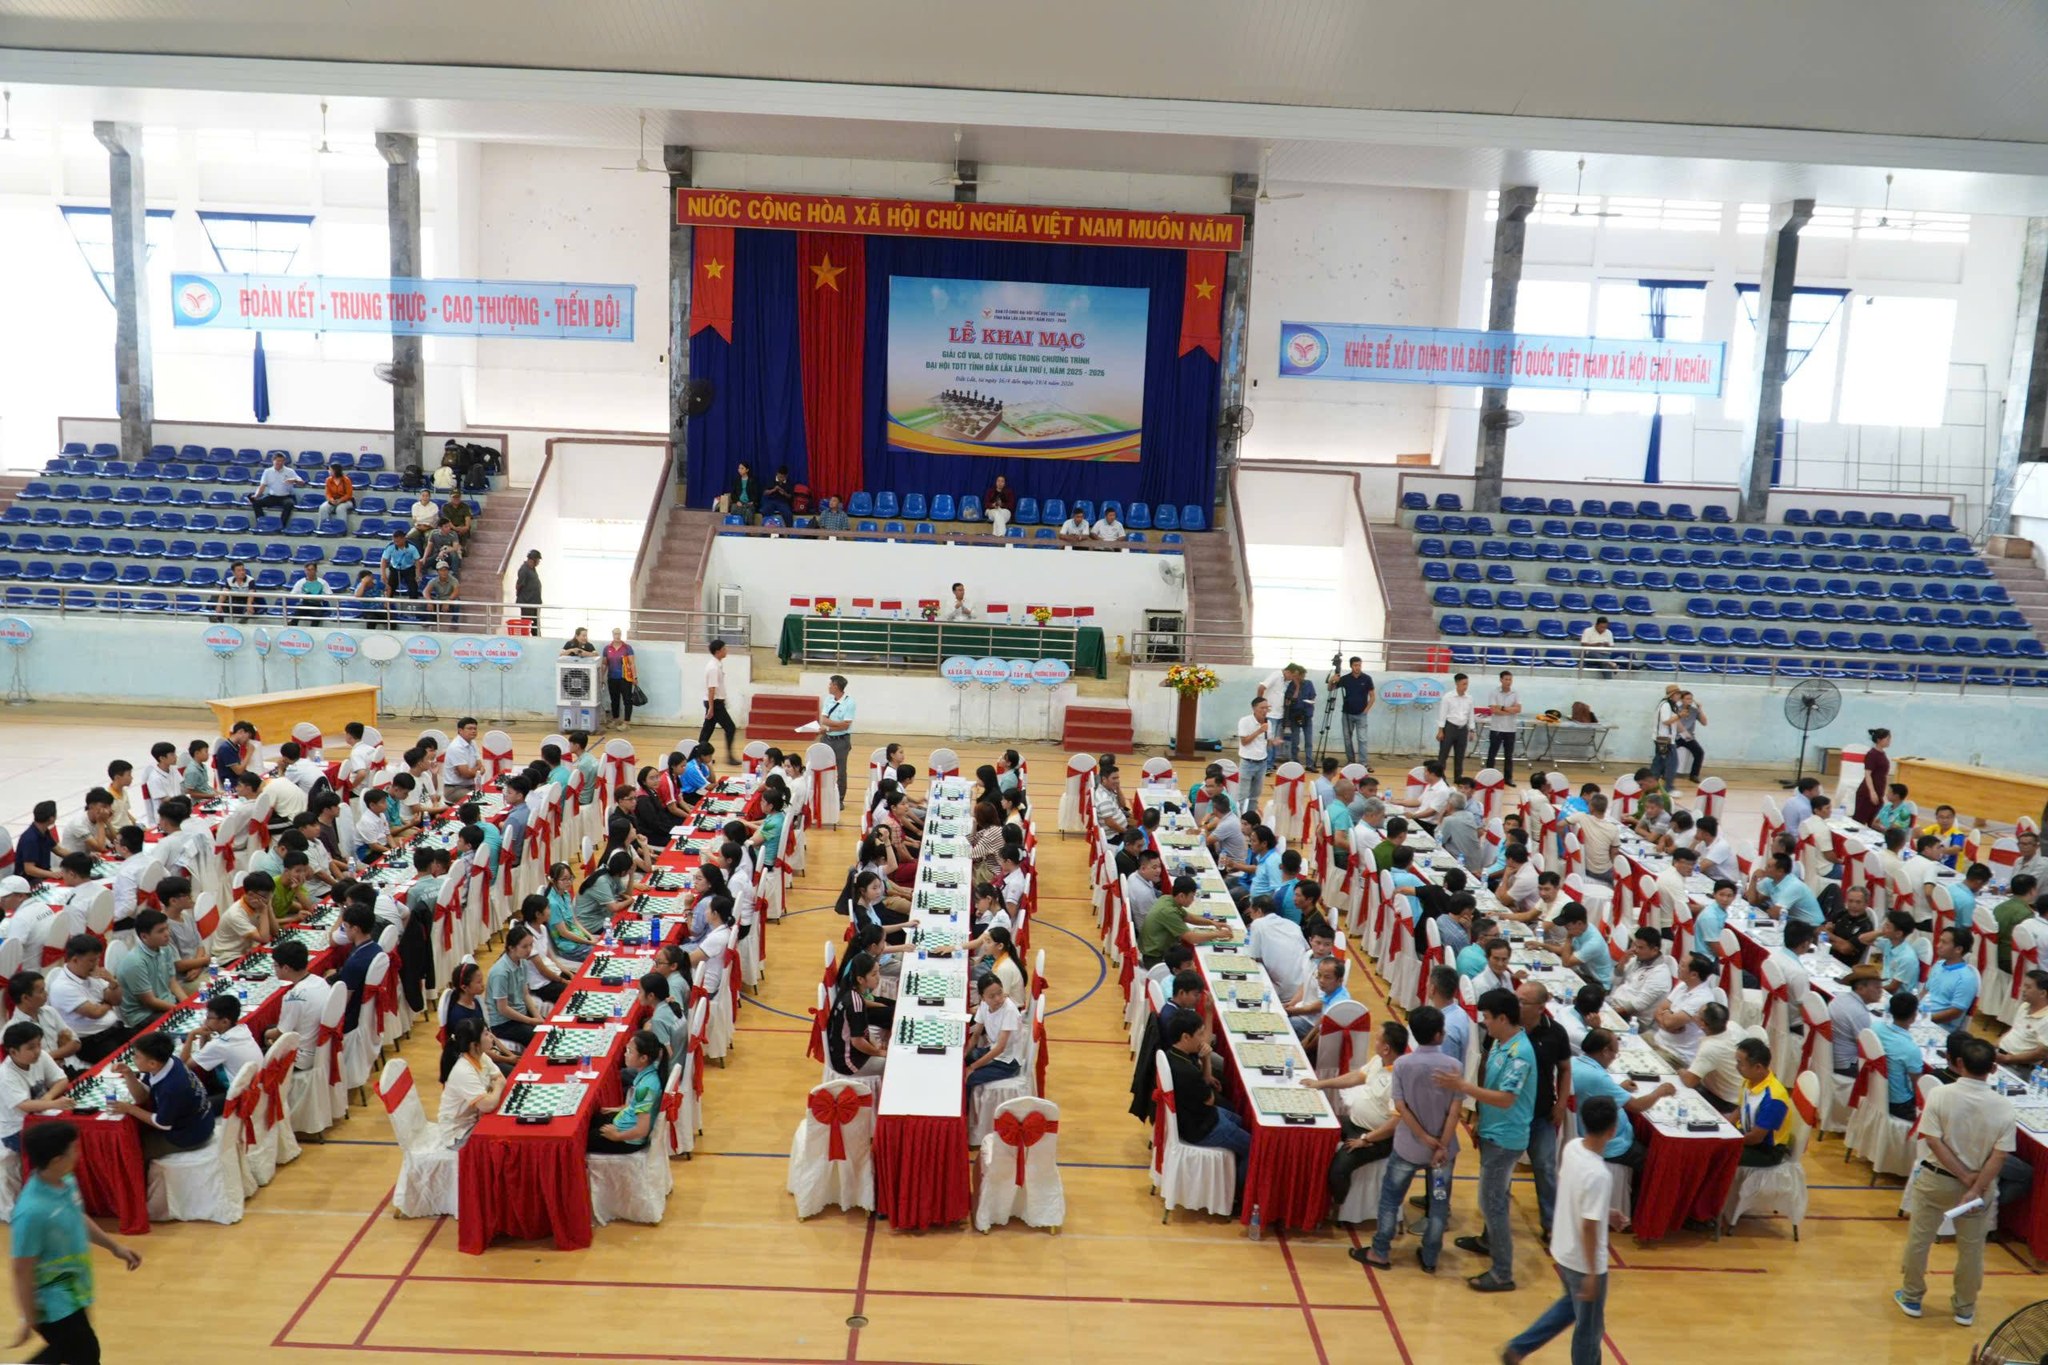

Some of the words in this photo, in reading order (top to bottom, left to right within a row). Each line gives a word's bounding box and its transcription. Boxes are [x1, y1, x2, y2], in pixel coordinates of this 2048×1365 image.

[688, 194, 741, 219] NƯỚC
[747, 196, 801, 224] CỘNG
[807, 198, 846, 225] HÒA
[853, 203, 881, 226] XÃ
[887, 203, 920, 231] HỘI
[926, 204, 965, 231] CHỦ
[970, 207, 1028, 234] NGHĨA
[1032, 211, 1074, 239] VIỆT
[1079, 216, 1123, 238] NAM
[1128, 216, 1185, 240] MUÔN
[1189, 218, 1233, 242] NĂM
[239, 283, 283, 319] ĐOÀN
[288, 281, 315, 319] KẾT
[330, 291, 383, 321] TRUNG
[386, 290, 427, 328] THỰC
[442, 295, 473, 324] CAO
[477, 293, 540, 331] THƯỢNG
[554, 289, 590, 327] TIẾN
[594, 293, 621, 334] BỘ!
[949, 320, 976, 343] LỄ
[982, 328, 1034, 346] KHAI
[1039, 331, 1085, 351] MẠC
[952, 362, 967, 370] TDTT
[1067, 368, 1082, 376] 2025
[1088, 369, 1105, 377] 2026
[1018, 354, 1040, 362] TRONG
[1344, 334, 1374, 368] KHỎE
[1375, 333, 1393, 369] ĐỂ
[1393, 338, 1416, 370] XÂY
[1417, 342, 1448, 376] DỰNG
[1451, 341, 1465, 372] VÀ
[1468, 339, 1490, 373] BẢO
[1493, 343, 1506, 380] VỆ
[1509, 340, 1525, 375] TỔ
[1525, 342, 1554, 377] QUỐC
[1557, 347, 1582, 383] VIỆT
[1583, 353, 1608, 378] NAM
[1611, 351, 1626, 379] XÃ
[1629, 351, 1647, 386] HỘI
[1651, 349, 1672, 382] CHỦ
